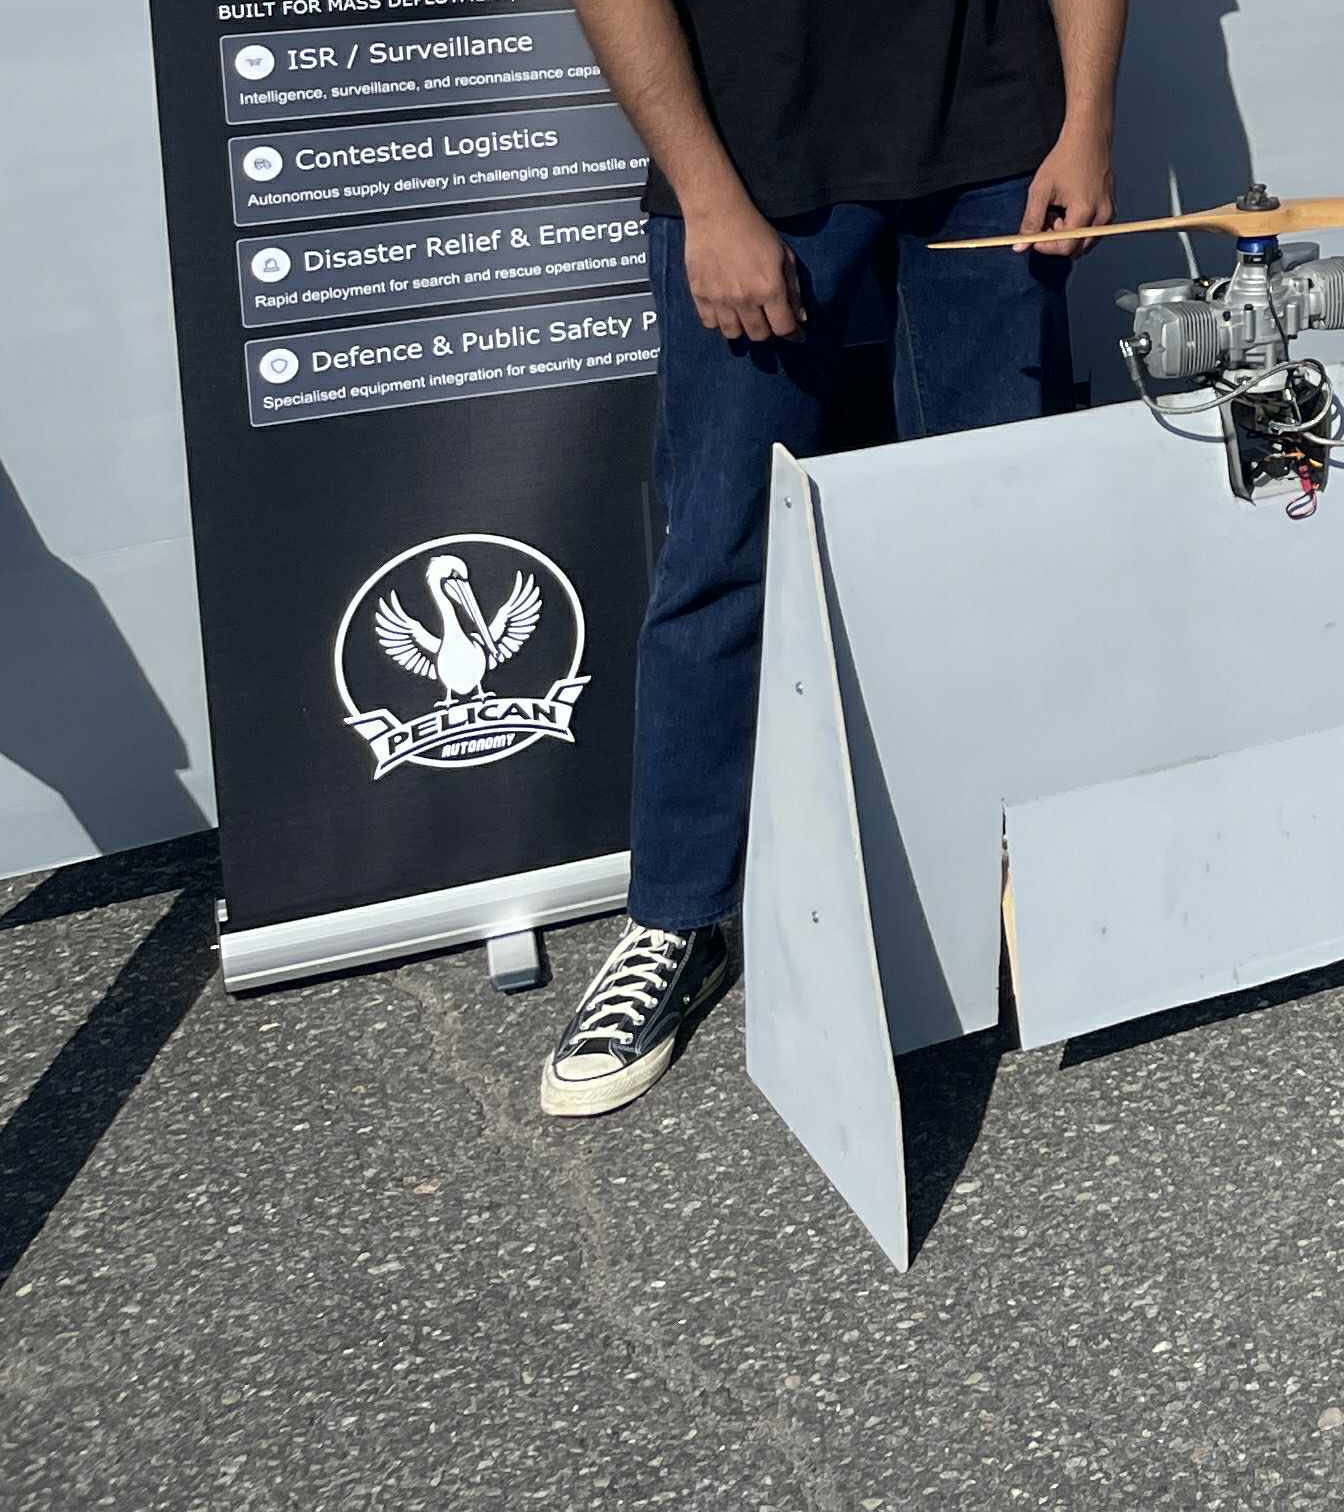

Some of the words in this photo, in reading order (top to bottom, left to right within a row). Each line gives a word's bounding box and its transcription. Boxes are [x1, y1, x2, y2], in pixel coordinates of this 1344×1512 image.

[218, 1, 276, 20] BUILT
[282, 0, 322, 16] FOR
[287, 47, 338, 71] ISR
[347, 44, 359, 69] /
[369, 35, 533, 64] Surveillance
[240, 86, 327, 105] Intelligence,
[331, 79, 421, 98] surveillance,
[424, 76, 450, 90] and
[454, 69, 564, 87] reconnaissance
[567, 65, 601, 80] capa
[295, 137, 433, 170] Contested
[444, 129, 559, 157] Logistics
[247, 188, 340, 207] Autonomous
[344, 181, 391, 197] supply
[394, 175, 449, 191] delivery
[453, 173, 466, 185] in
[470, 166, 549, 184] challenging
[553, 162, 578, 176] and
[582, 158, 626, 173] hostile
[304, 243, 416, 272] Disaster
[427, 230, 502, 258] Relief
[510, 228, 531, 249] &
[255, 292, 298, 309] Rapid
[302, 281, 386, 303] deployment
[389, 279, 409, 291] for
[412, 272, 461, 288] search
[464, 269, 491, 283] and
[495, 265, 542, 279] rescue
[545, 255, 618, 275] operations
[621, 252, 647, 266] and
[312, 343, 423, 372] Defence
[432, 335, 454, 356] &
[462, 326, 541, 352] Public
[549, 316, 632, 343] Safety
[263, 386, 346, 410] Specialised
[350, 375, 425, 398] equipment
[429, 365, 503, 387] integration
[506, 363, 527, 377] for
[529, 356, 583, 374] security
[586, 353, 613, 367] and
[387, 702, 558, 756] PELICAN
